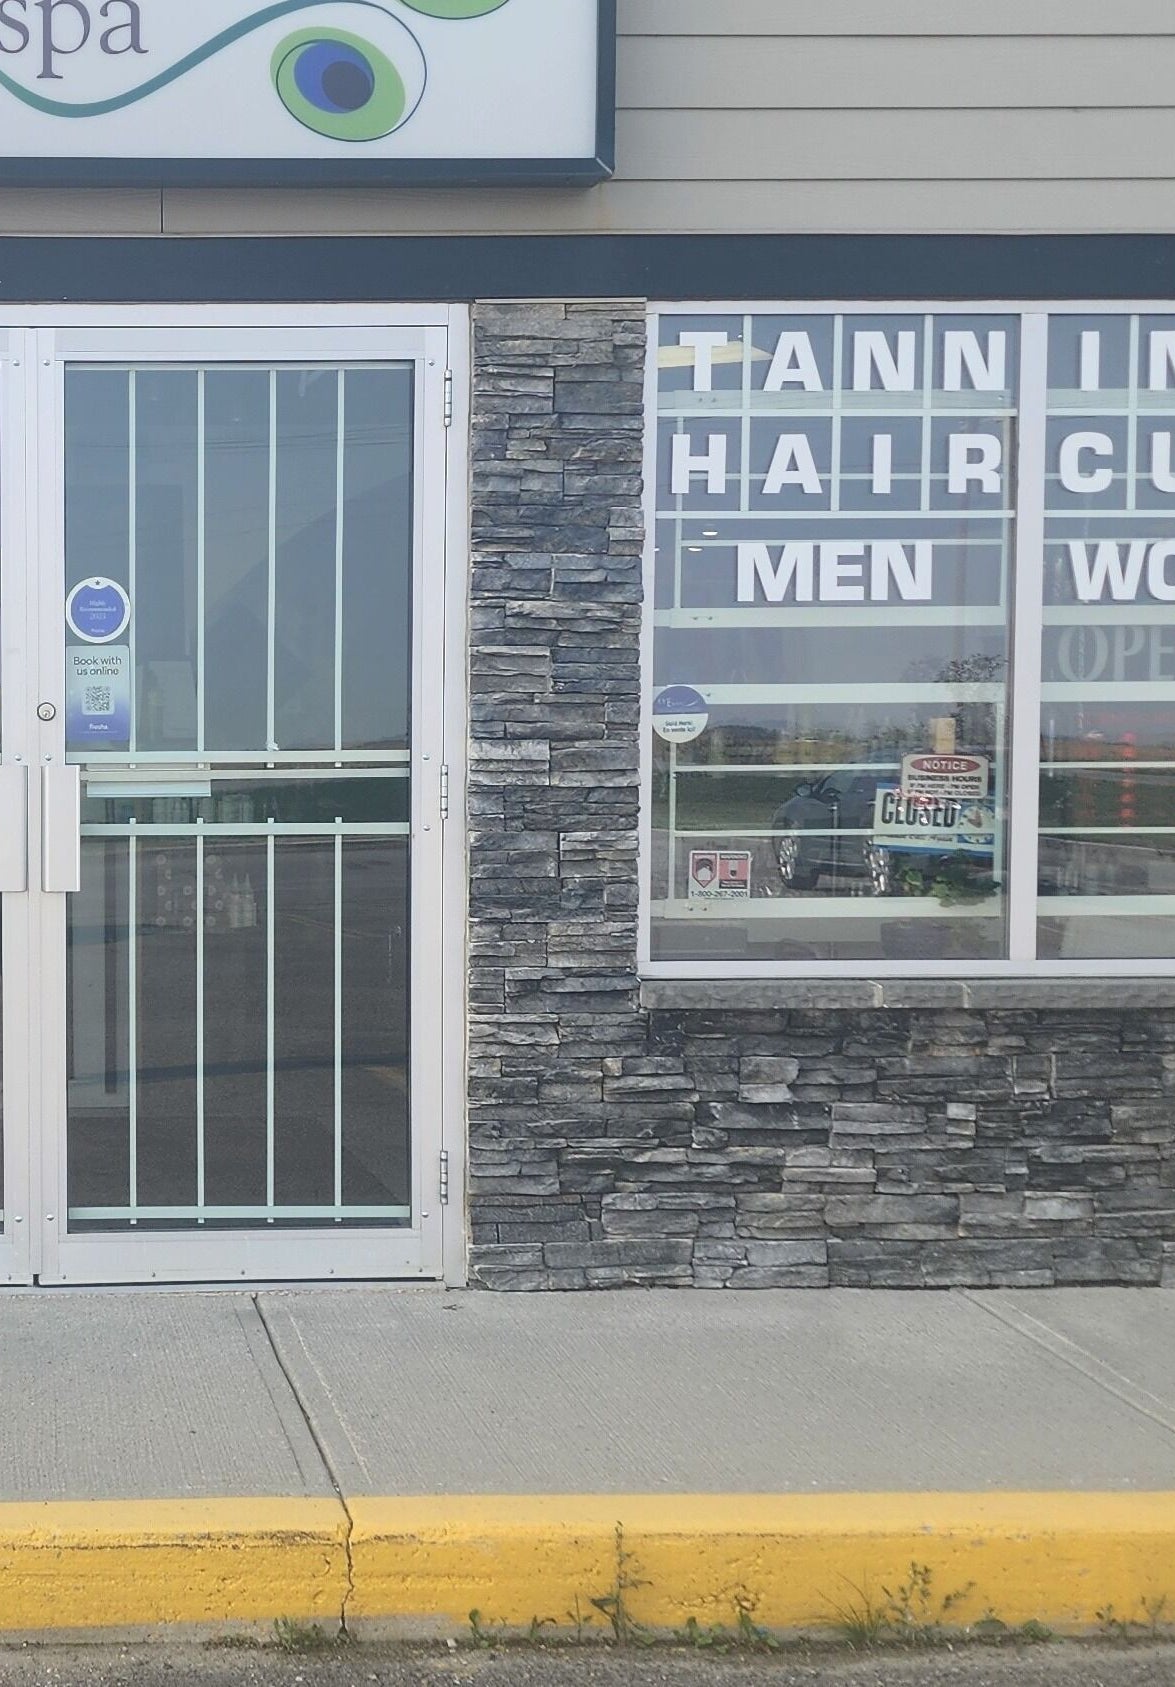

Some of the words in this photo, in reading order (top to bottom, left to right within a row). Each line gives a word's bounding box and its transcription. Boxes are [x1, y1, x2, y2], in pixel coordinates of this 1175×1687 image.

[671, 433, 1003, 494] HAIR
[736, 541, 933, 602] MEN
[73, 656, 99, 665] Book
[100, 656, 122, 665] with
[76, 668, 88, 676] us
[89, 666, 120, 676] online
[922, 760, 968, 771] NOTICE
[952, 775, 982, 783] HOURS
